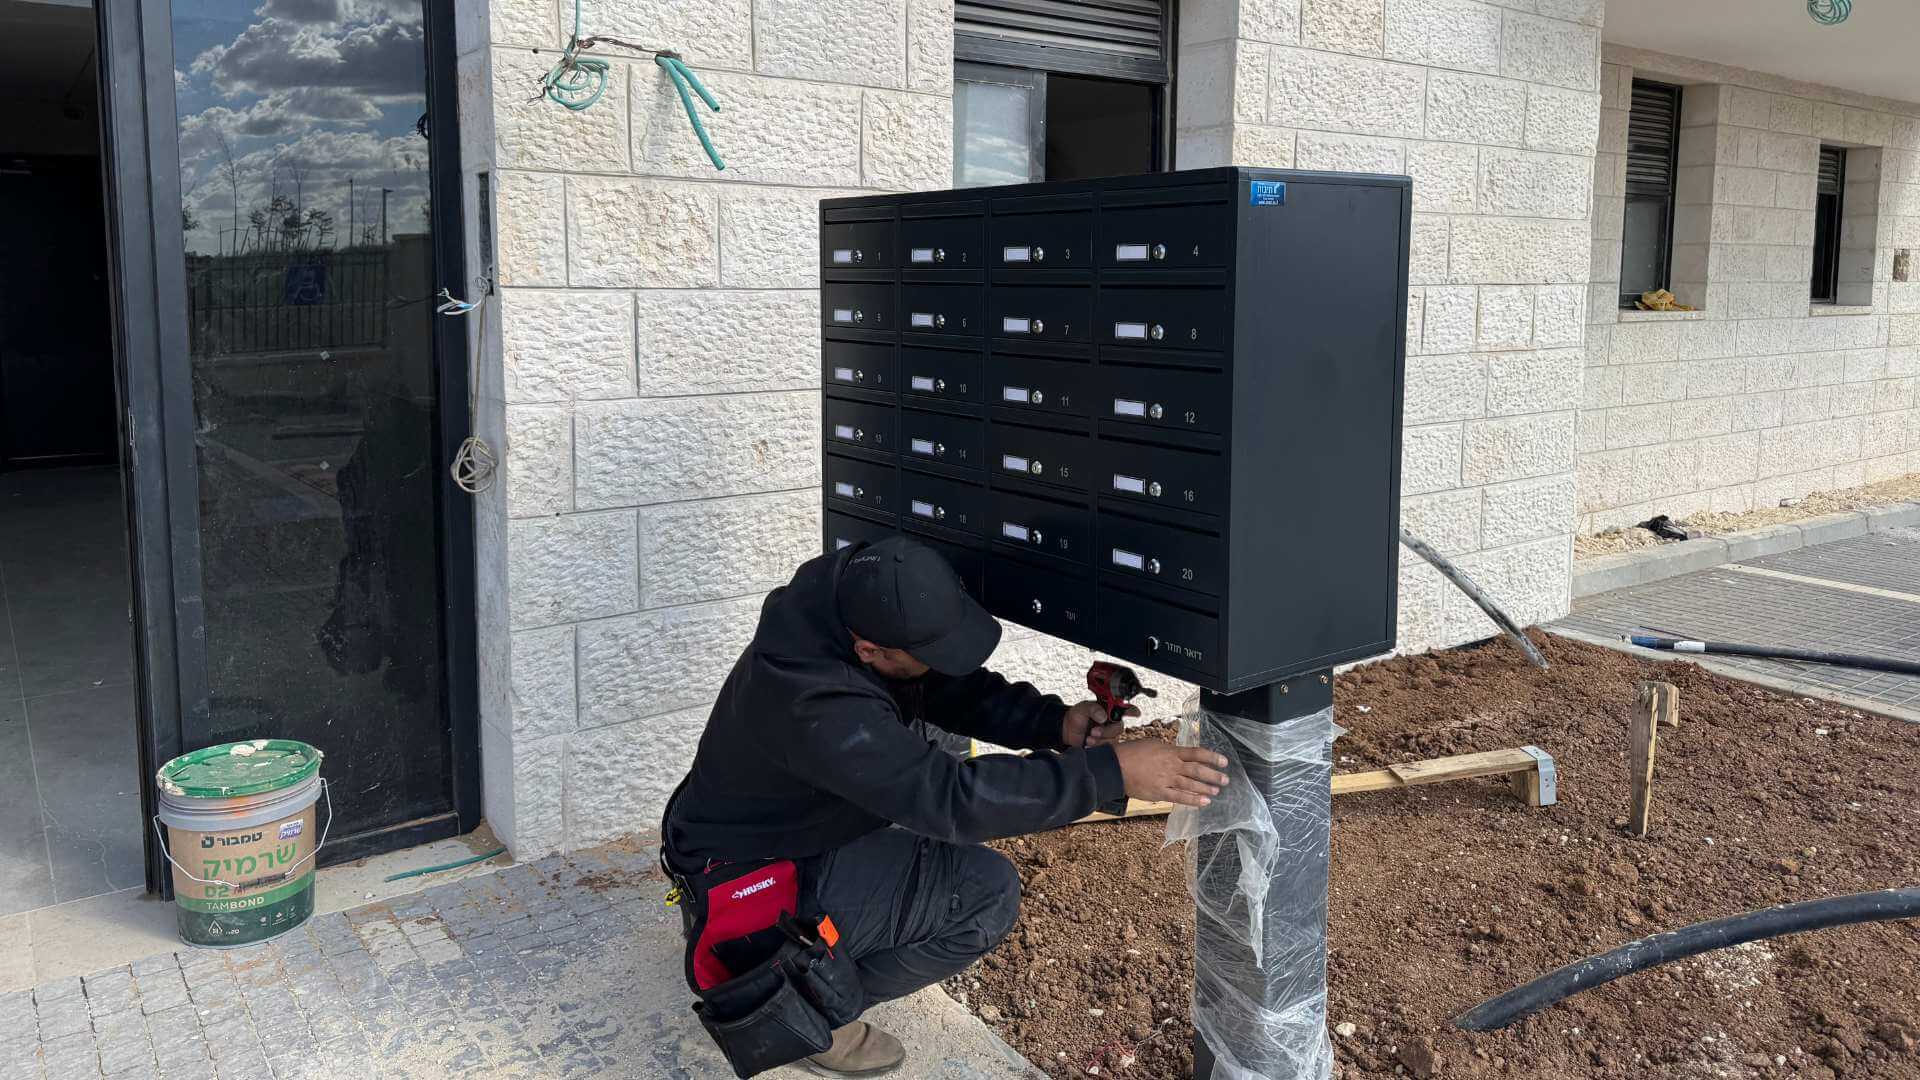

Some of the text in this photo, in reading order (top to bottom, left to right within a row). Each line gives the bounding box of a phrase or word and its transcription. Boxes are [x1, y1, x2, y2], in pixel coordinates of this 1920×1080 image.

[1065, 247, 1071, 260] 3
[1192, 244, 1199, 257] 4
[1064, 324, 1070, 336] 7
[1191, 327, 1197, 340] 8
[960, 383, 967, 393] 10
[1061, 395, 1070, 408] 11
[1184, 411, 1196, 424] 12
[1059, 465, 1070, 478] 15
[1184, 489, 1194, 502] 16
[1059, 537, 1069, 549] 19
[1182, 567, 1193, 581] 20
[1165, 641, 1203, 661] דואר חוזר
[217, 831, 263, 847] טמבור
[203, 843, 296, 881] שרמיק
[743, 877, 773, 896] HUSKY
[206, 896, 264, 910] TAMBOND
